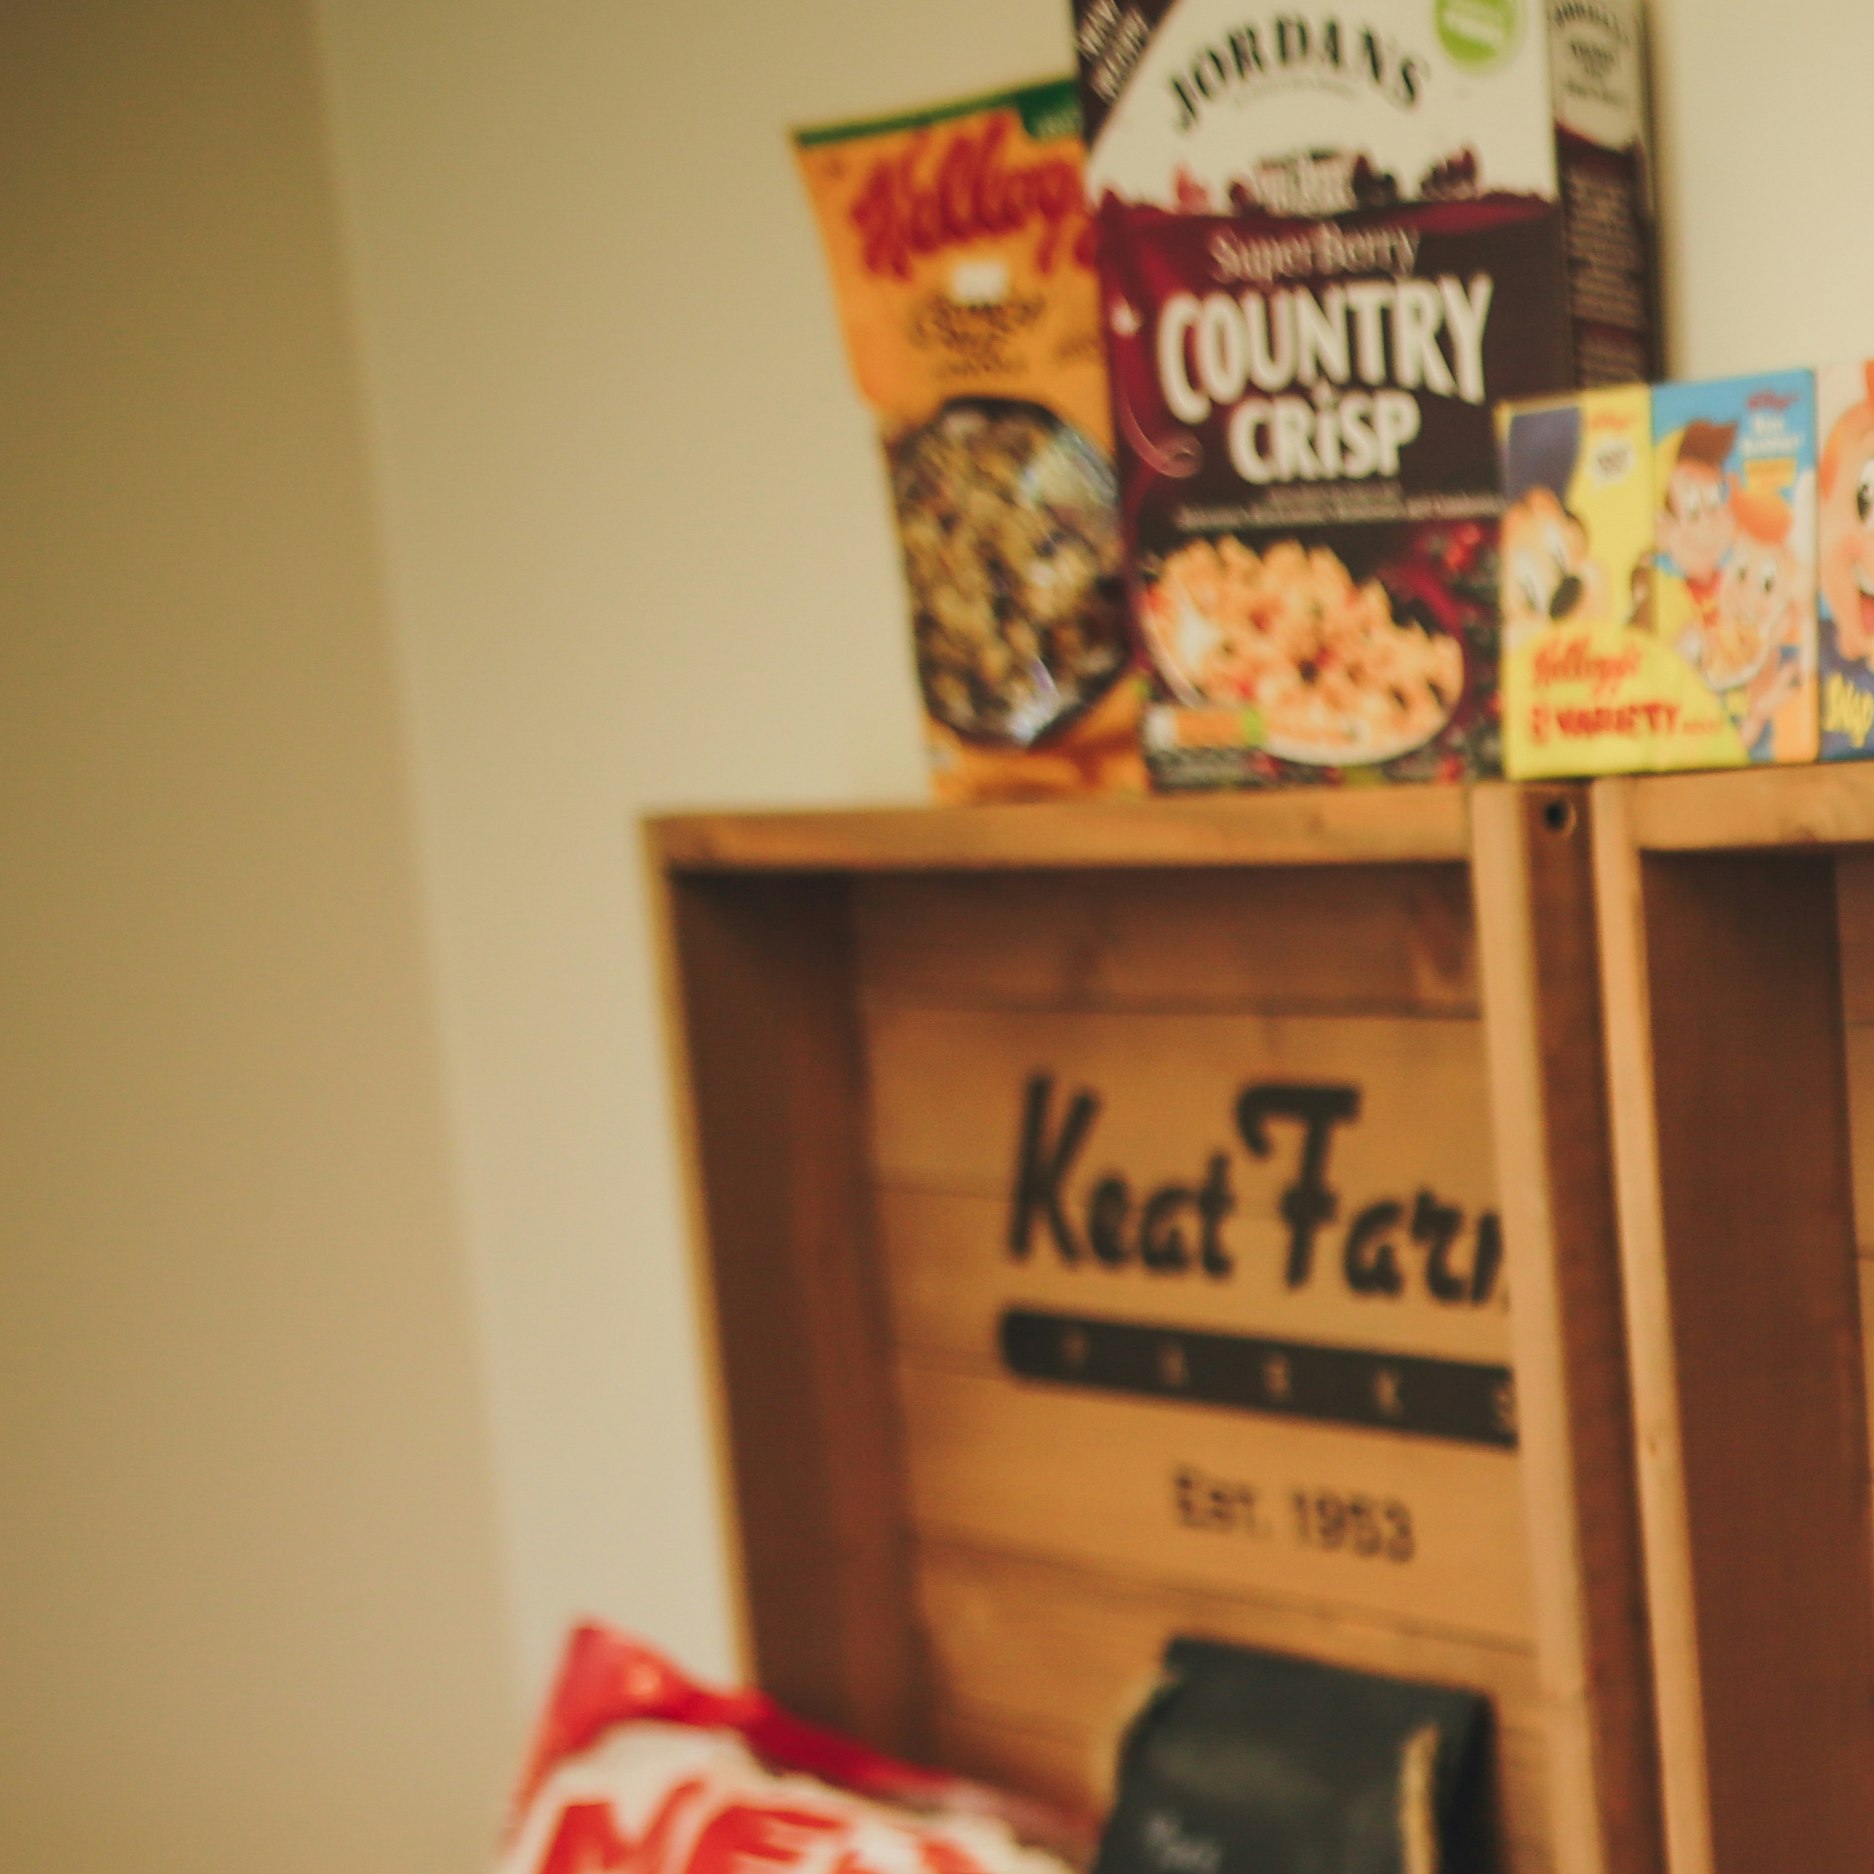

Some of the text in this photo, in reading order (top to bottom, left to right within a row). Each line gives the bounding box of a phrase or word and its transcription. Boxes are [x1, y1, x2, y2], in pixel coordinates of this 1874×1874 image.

[1157, 273, 1493, 426] COUNTRY
[1007, 1071, 1233, 1282] Keat
[1292, 1485, 1417, 1565] 1953
